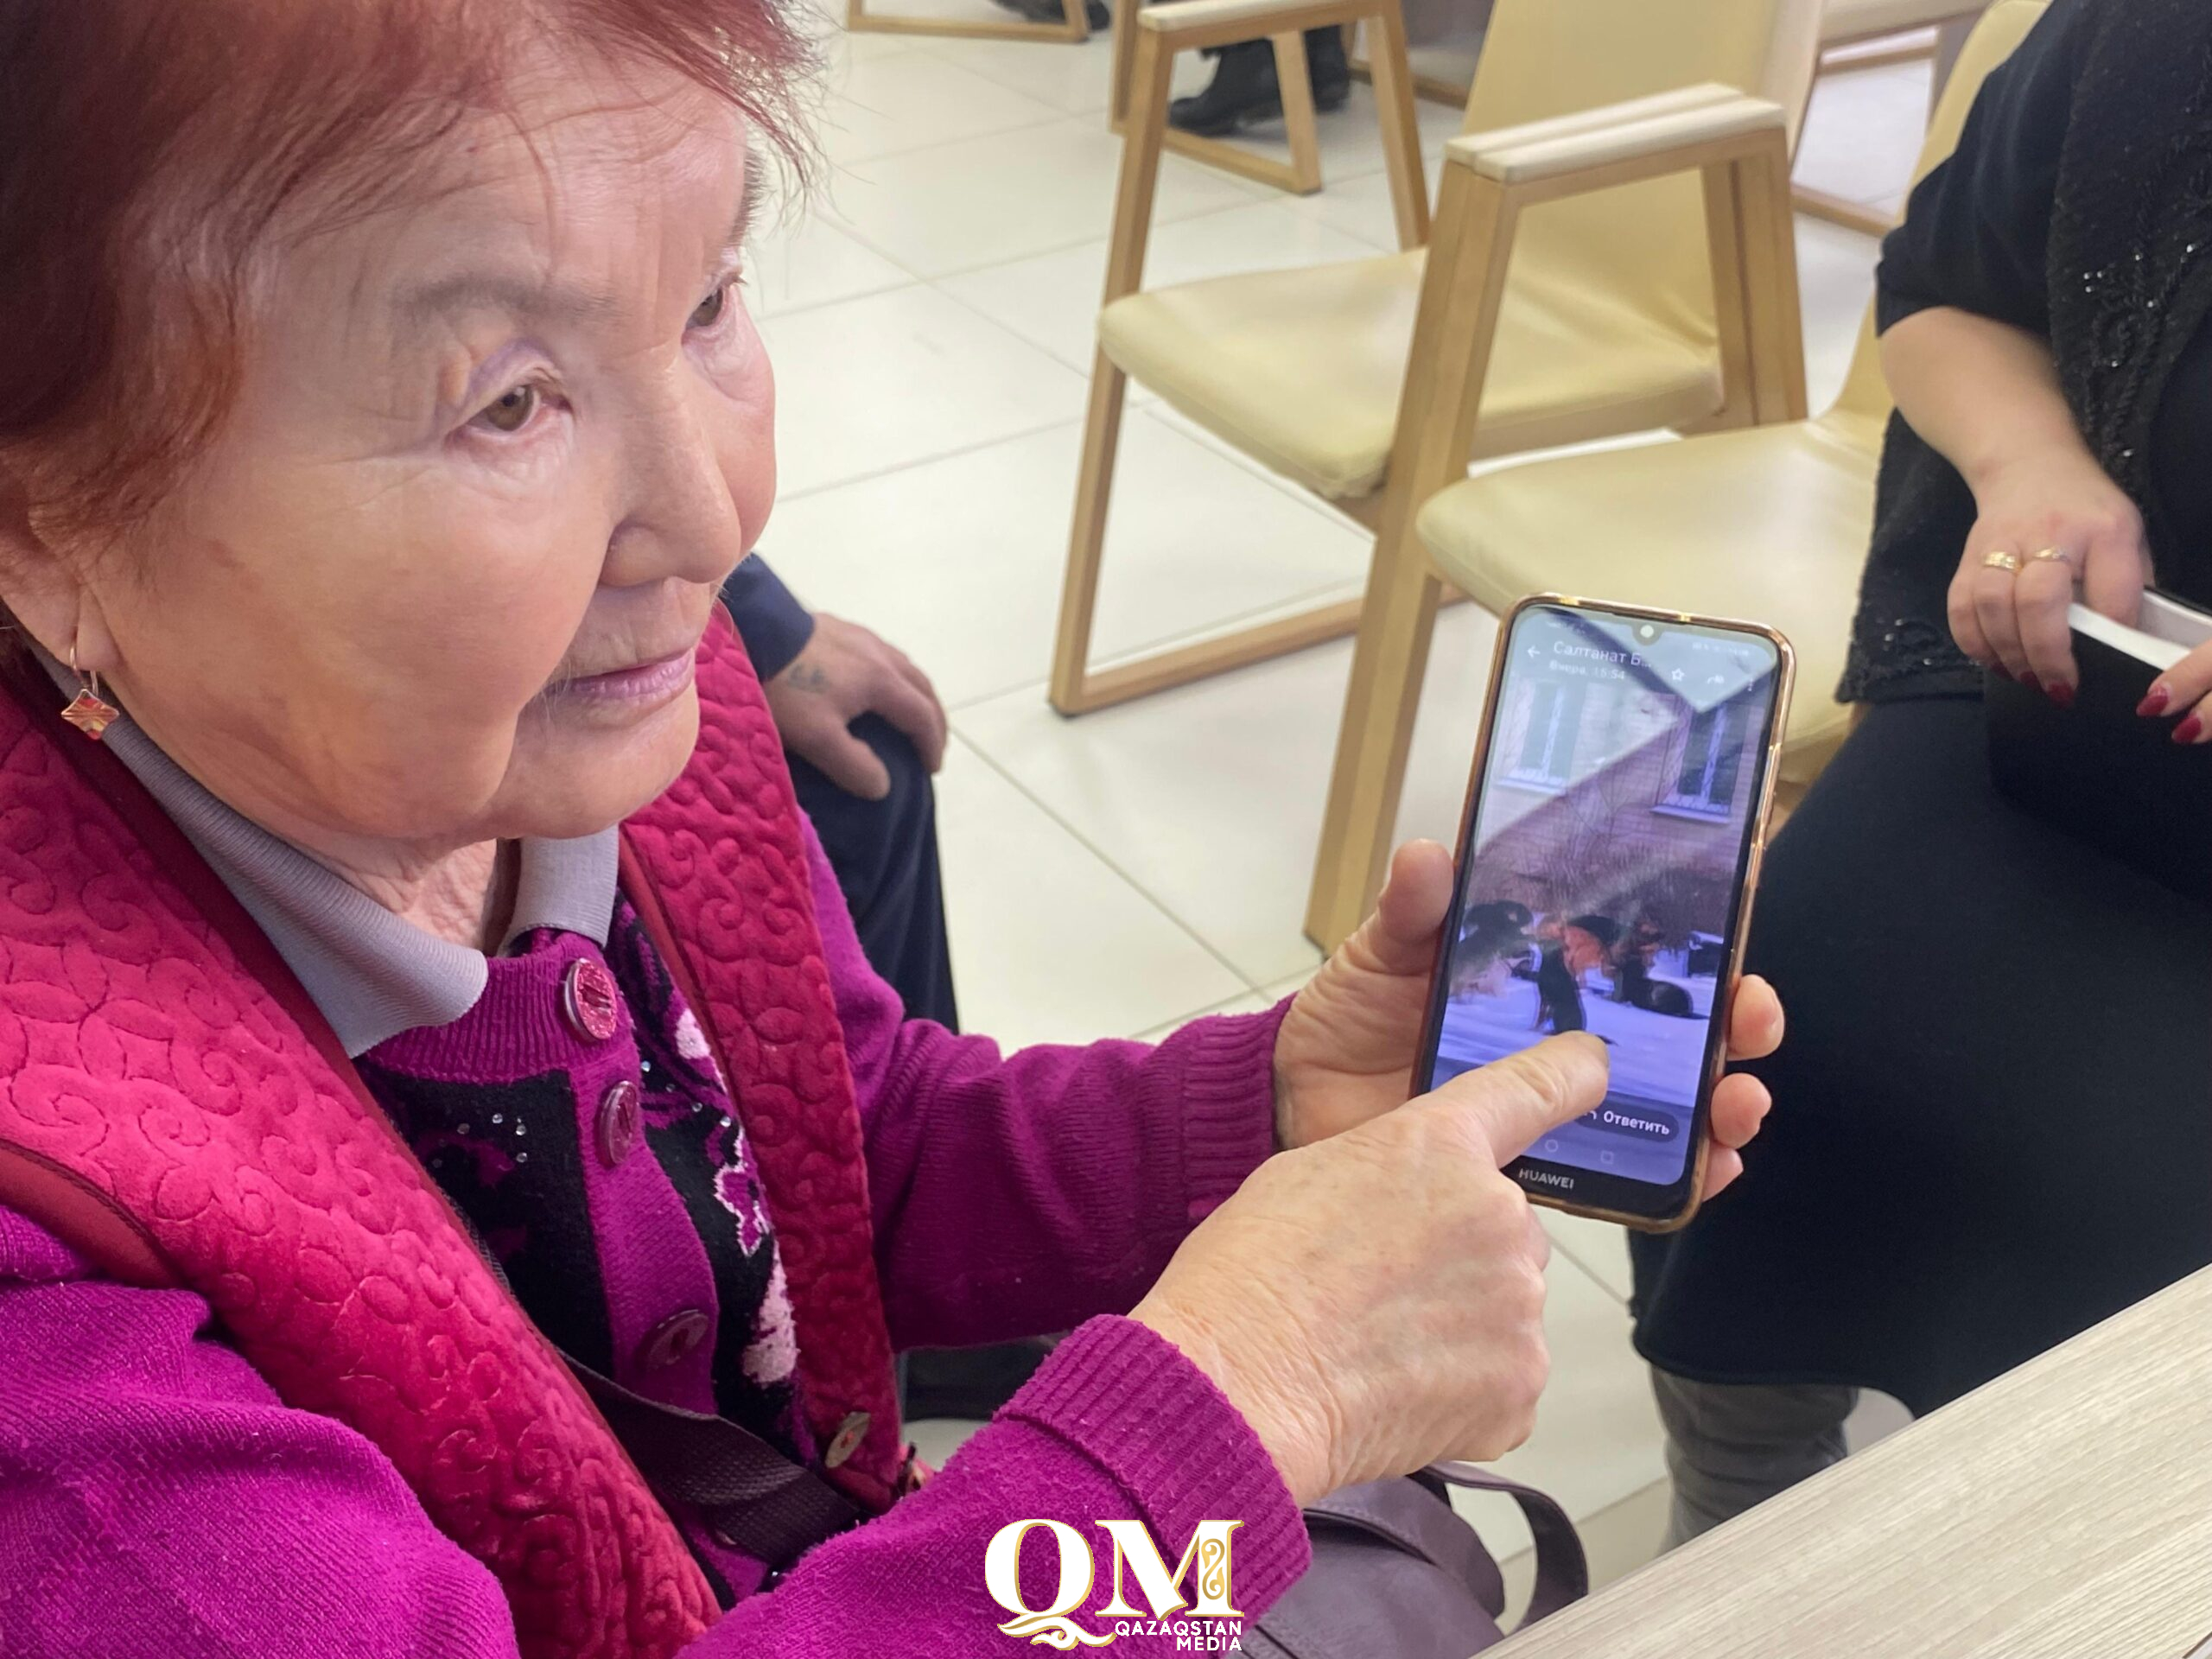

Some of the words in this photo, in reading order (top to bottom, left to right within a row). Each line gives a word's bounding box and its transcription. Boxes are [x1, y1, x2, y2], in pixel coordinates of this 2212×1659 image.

[1554, 640, 1627, 664] Салтанат
[1604, 1110, 1669, 1135] Ответить
[1519, 1168, 1574, 1189] HUAWEI
